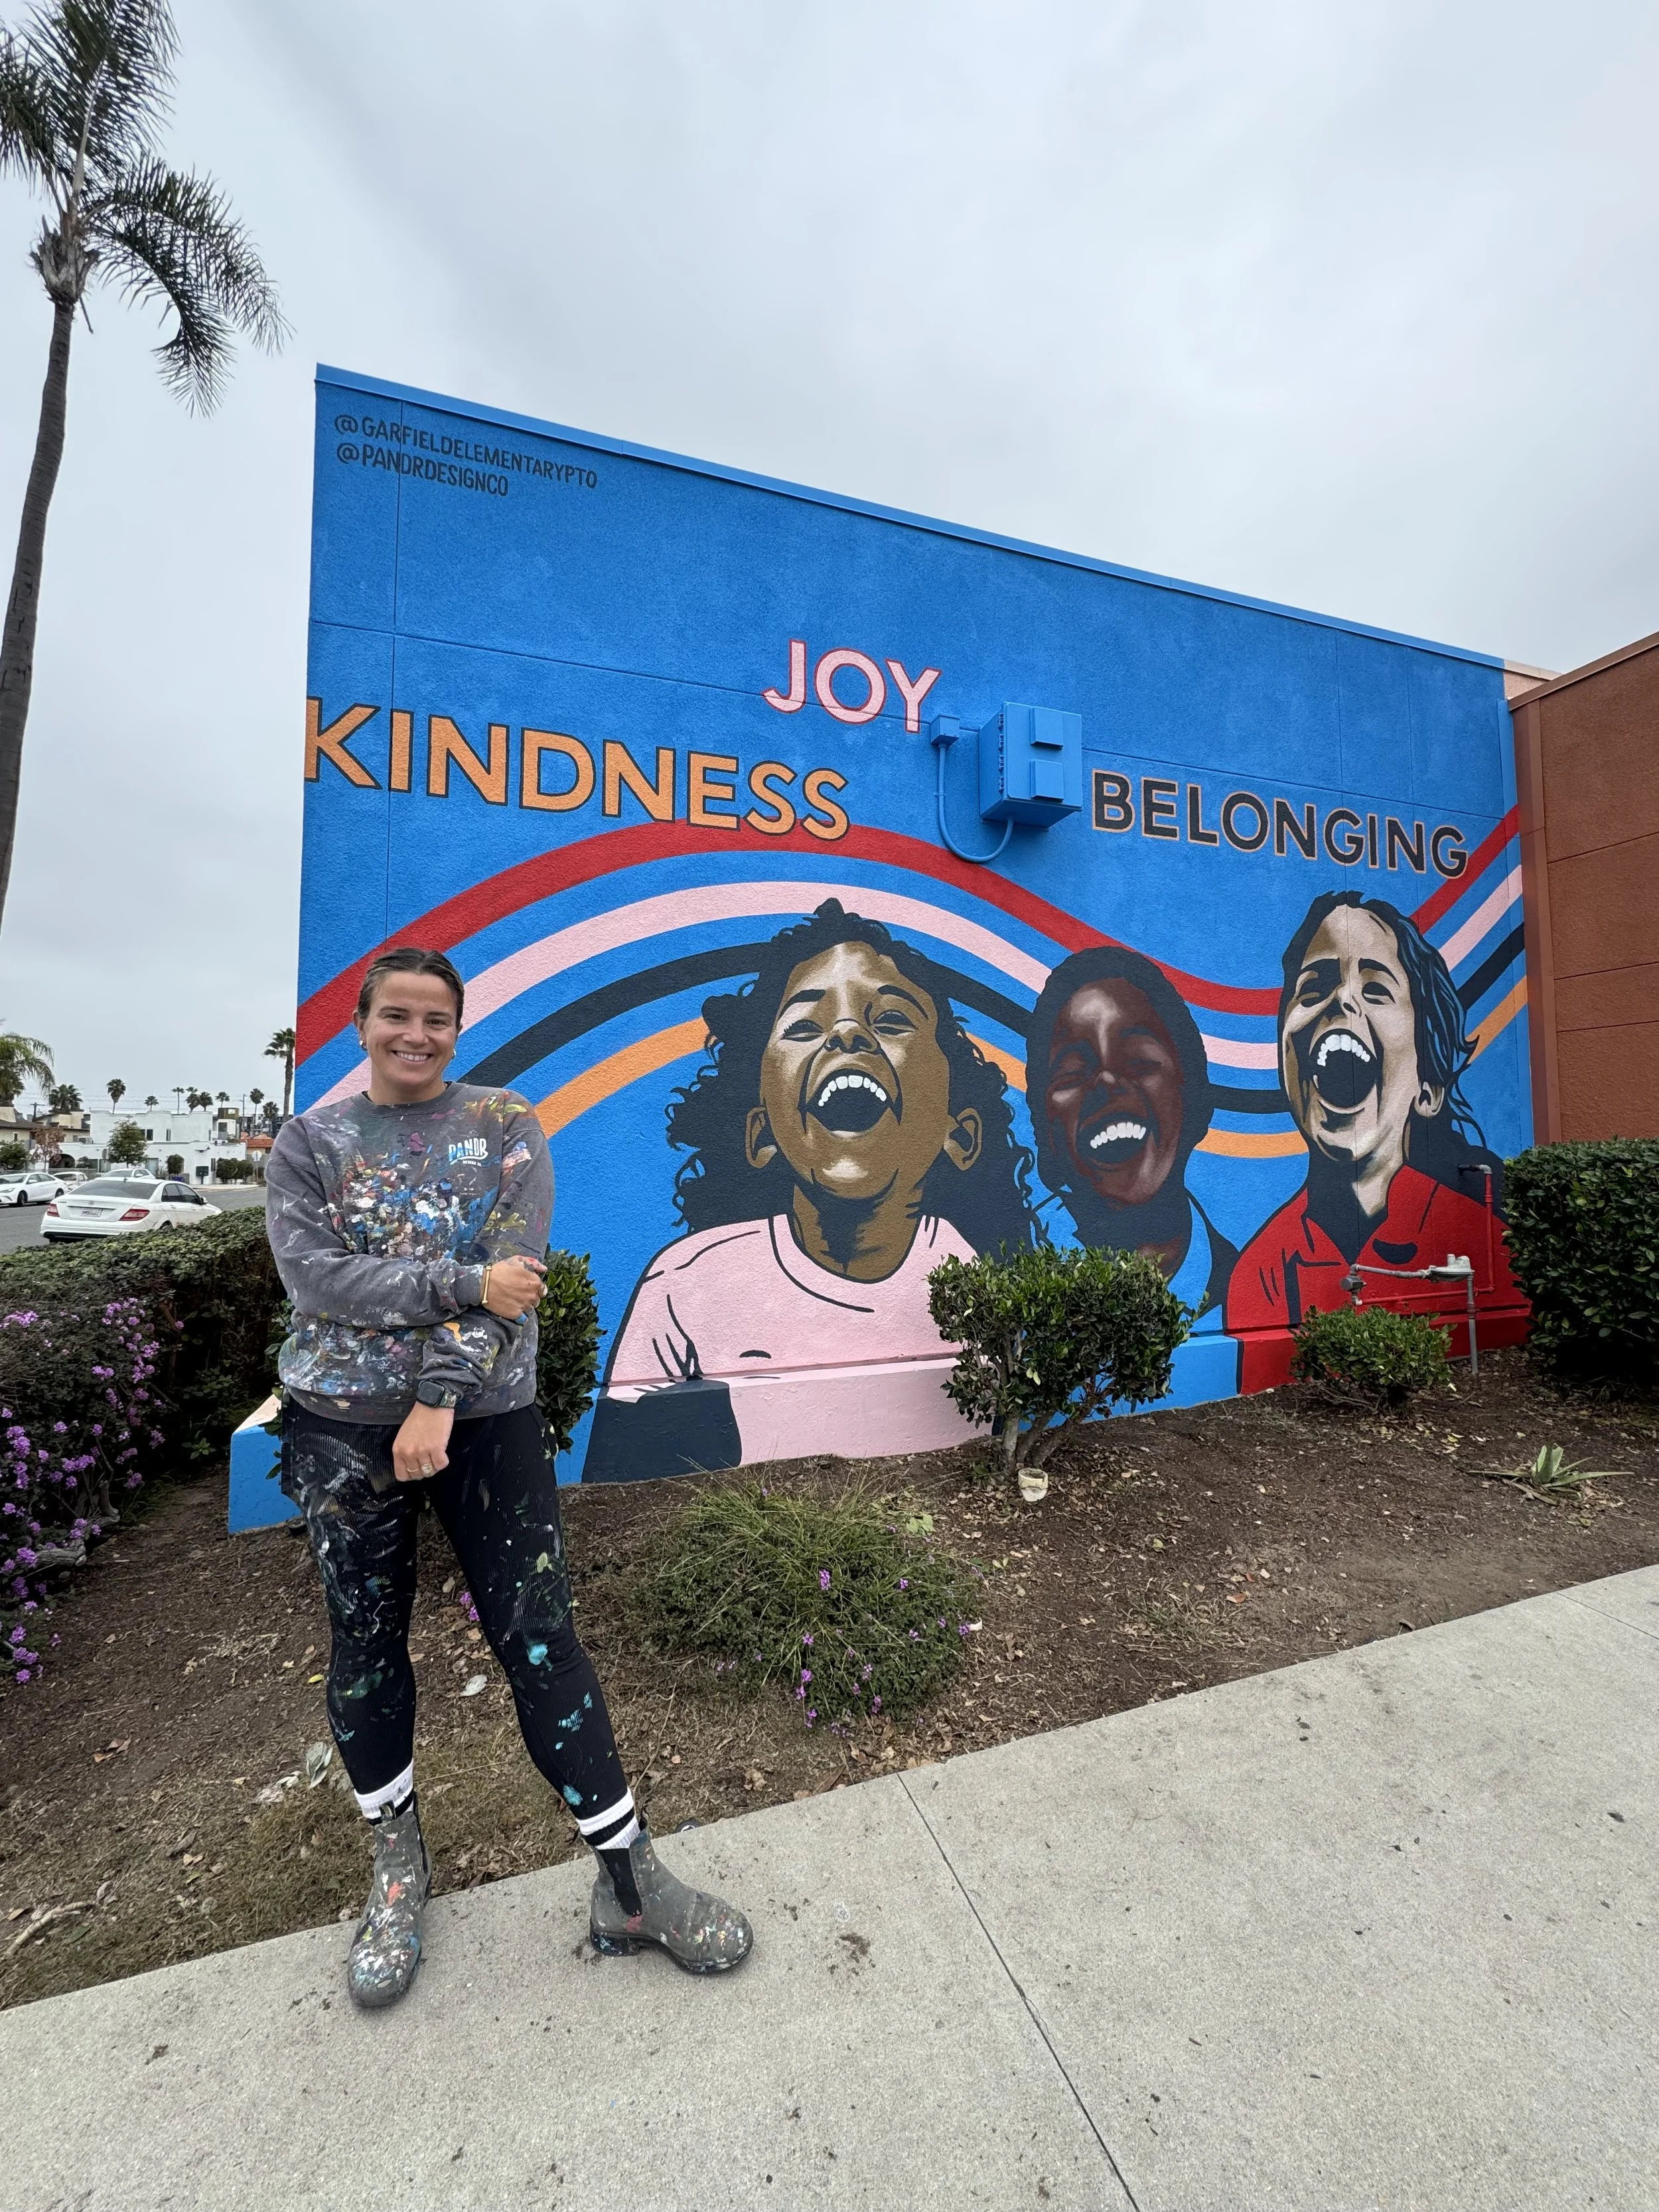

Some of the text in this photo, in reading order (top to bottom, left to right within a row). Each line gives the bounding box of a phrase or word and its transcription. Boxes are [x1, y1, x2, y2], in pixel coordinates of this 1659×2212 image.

[334, 414, 597, 488] @GARFIELDELEMENTARYPTO
[337, 443, 508, 496] @PANDRDESIGNCO
[762, 639, 940, 733] JOY
[304, 696, 850, 841] KINDNESS
[1092, 769, 1469, 880] BELONGING
[449, 1138, 488, 1165] PANDR
